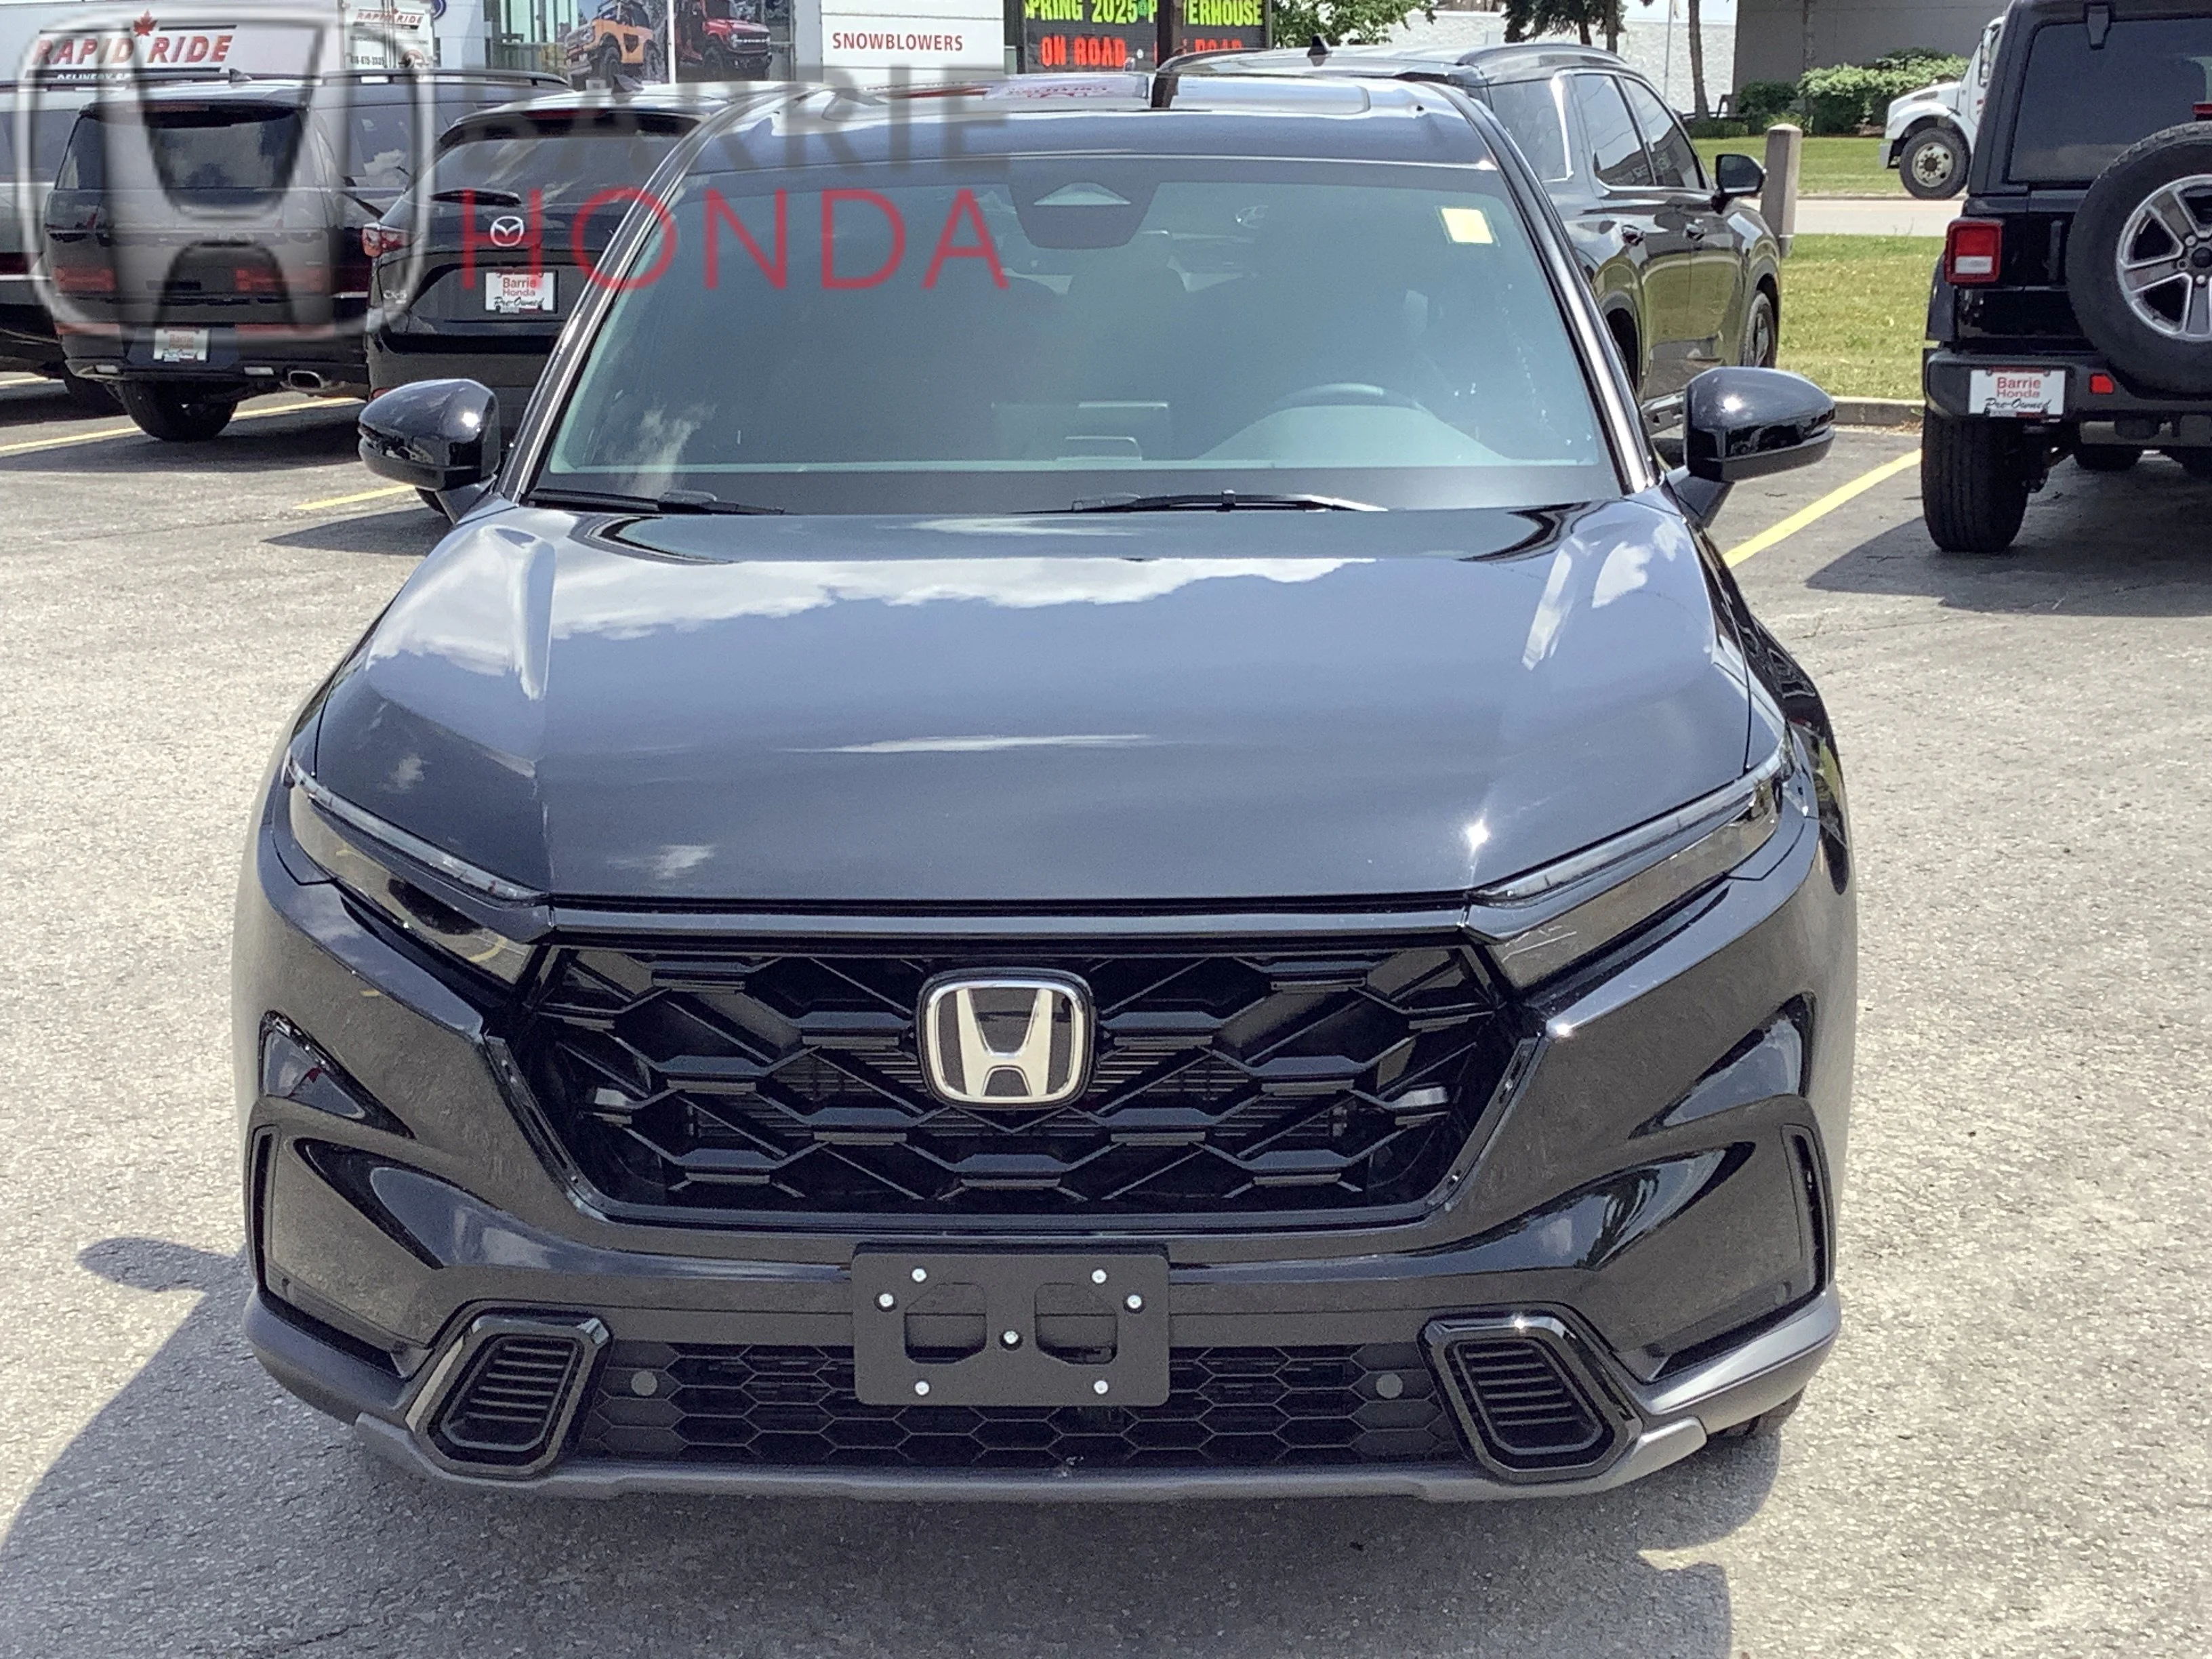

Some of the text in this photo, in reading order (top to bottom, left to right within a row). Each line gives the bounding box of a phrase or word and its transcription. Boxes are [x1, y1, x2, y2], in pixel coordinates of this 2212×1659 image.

[1091, 0, 1138, 24] 2025
[395, 15, 423, 24] RIDE
[832, 32, 963, 52] SNOWBLOWERS
[31, 35, 233, 66] RAPID RIDE
[1041, 35, 1067, 67] ON
[1074, 37, 1126, 67] ROAD
[503, 276, 537, 289] Barrie
[502, 288, 536, 297] Honda
[1997, 377, 2041, 389] Barrie
[1997, 389, 2041, 398] Honda
[1984, 397, 2052, 409] Pre-Owned
